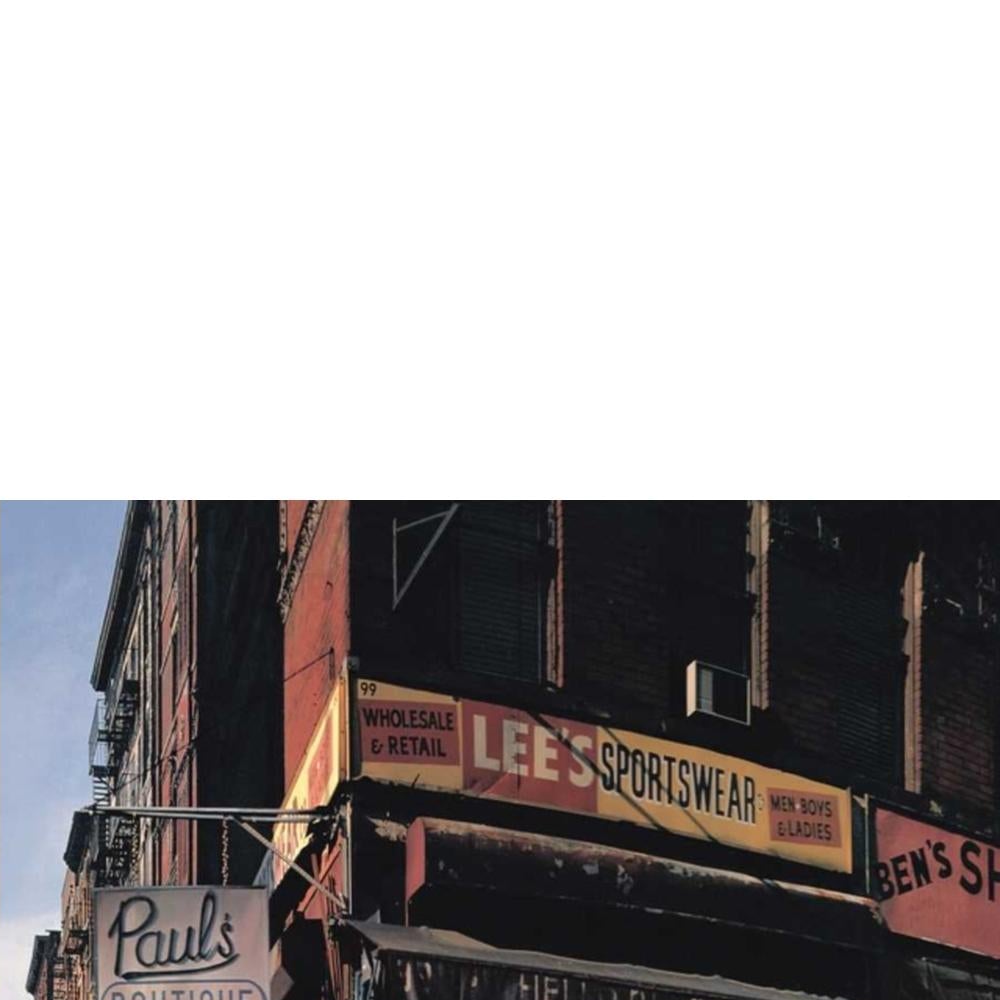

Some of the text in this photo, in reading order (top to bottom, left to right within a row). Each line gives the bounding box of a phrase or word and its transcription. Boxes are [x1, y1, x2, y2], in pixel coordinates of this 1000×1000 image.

[360, 682, 377, 697] 99
[362, 708, 454, 731] WHOLESALE
[371, 735, 447, 758] & RETAIL
[473, 714, 755, 824] LEE'S SPORTSWEAR
[800, 798, 833, 818] BOYS
[788, 820, 833, 841] LADIES
[874, 840, 953, 901] BEN'S
[108, 890, 241, 982] Paul's
